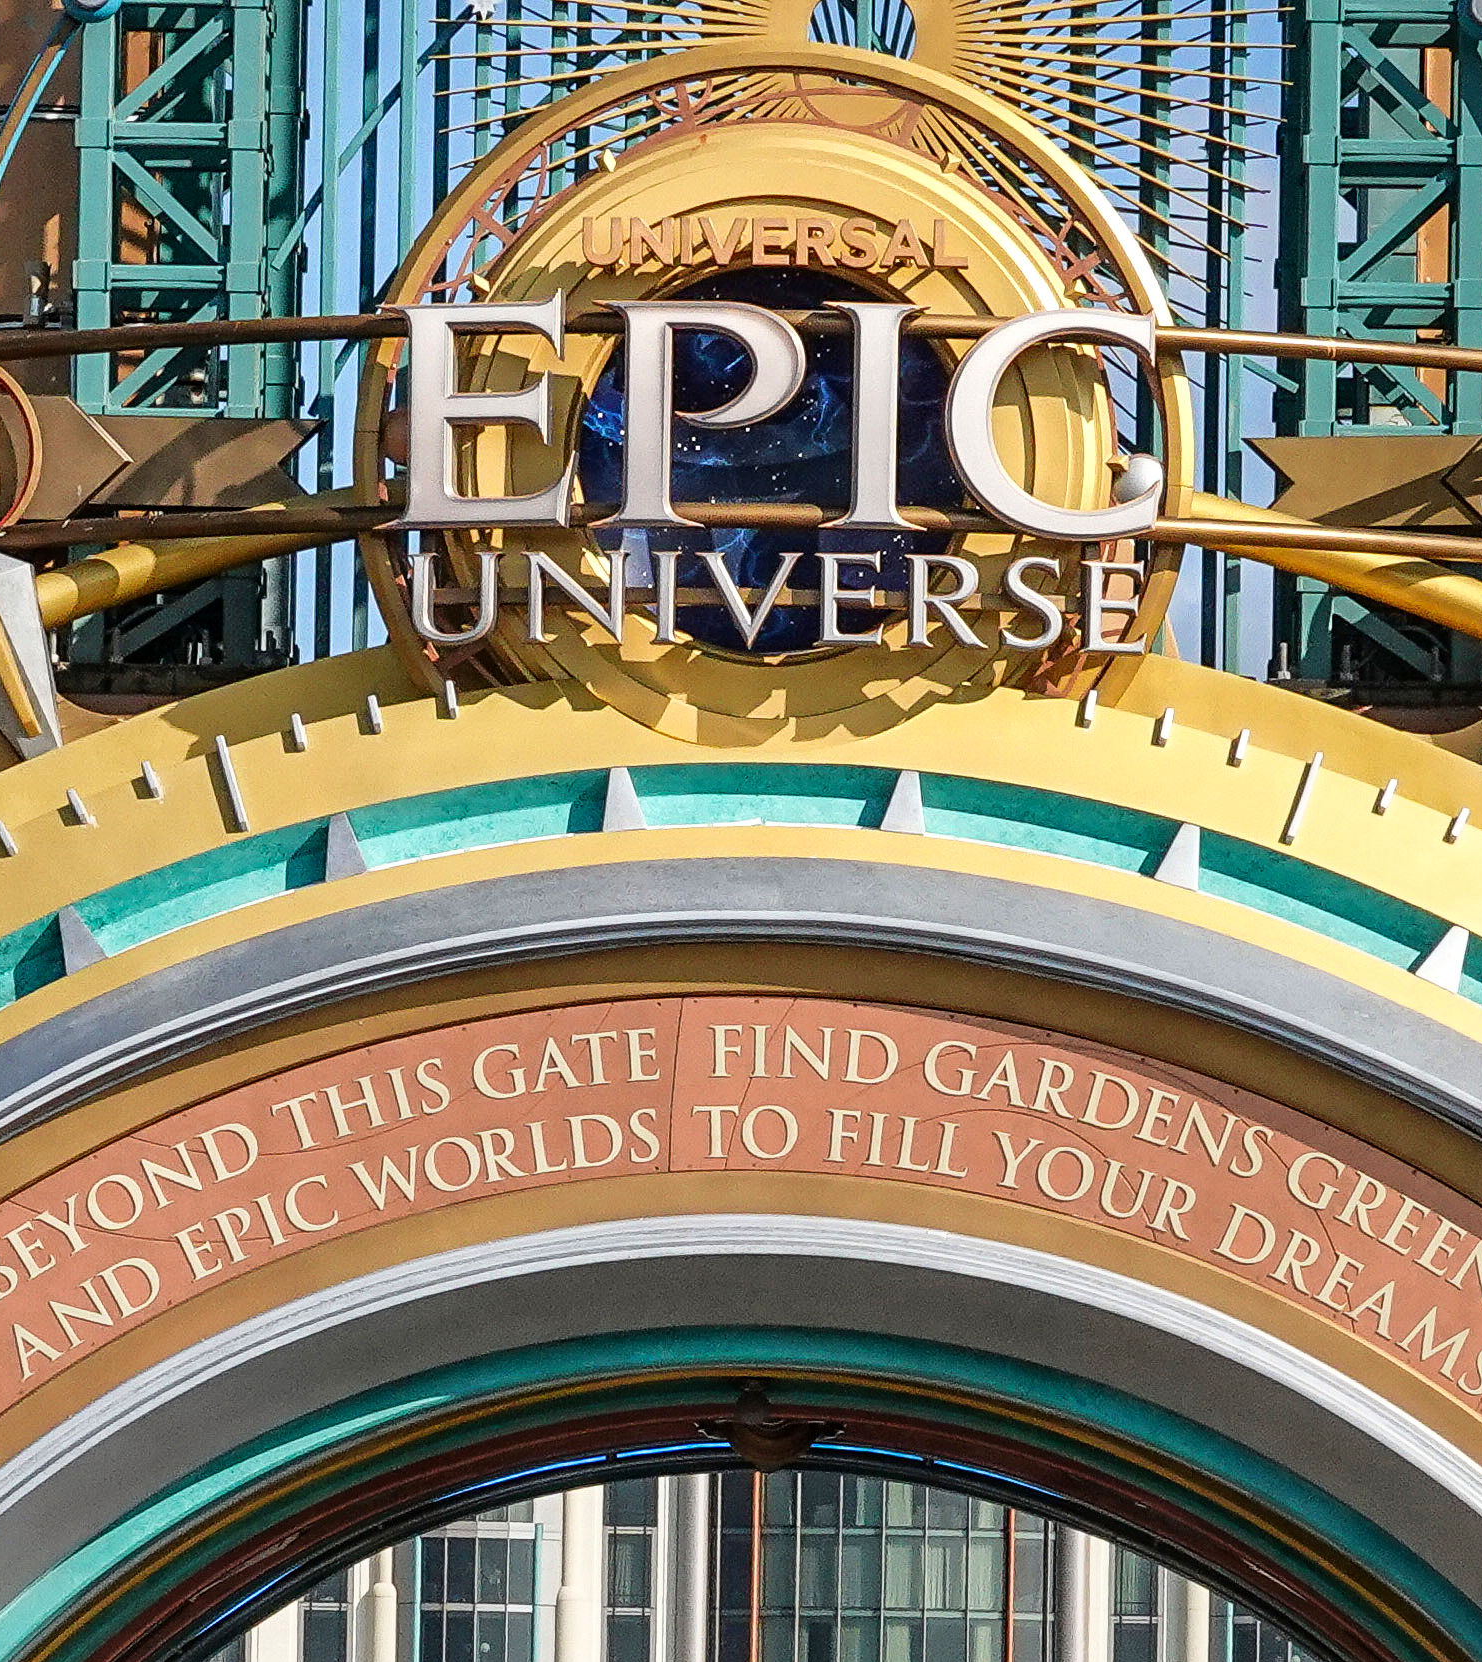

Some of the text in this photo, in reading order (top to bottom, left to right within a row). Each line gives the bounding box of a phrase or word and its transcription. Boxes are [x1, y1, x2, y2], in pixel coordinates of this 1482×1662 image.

[581, 217, 968, 269] UNIVERSAL
[375, 288, 1165, 540] EPIC
[408, 550, 1147, 655] UNIVERSE
[271, 1058, 451, 1151] THIS
[472, 1028, 660, 1099] GATE
[709, 1024, 900, 1084] FIND
[922, 1040, 1274, 1178] GARDENS
[11, 1258, 160, 1380] AND
[174, 1175, 338, 1283] EPIC
[350, 1109, 661, 1211] WORLDS
[692, 1105, 800, 1159] TO
[825, 1109, 969, 1178] FILL
[994, 1131, 1197, 1241] YOUR
